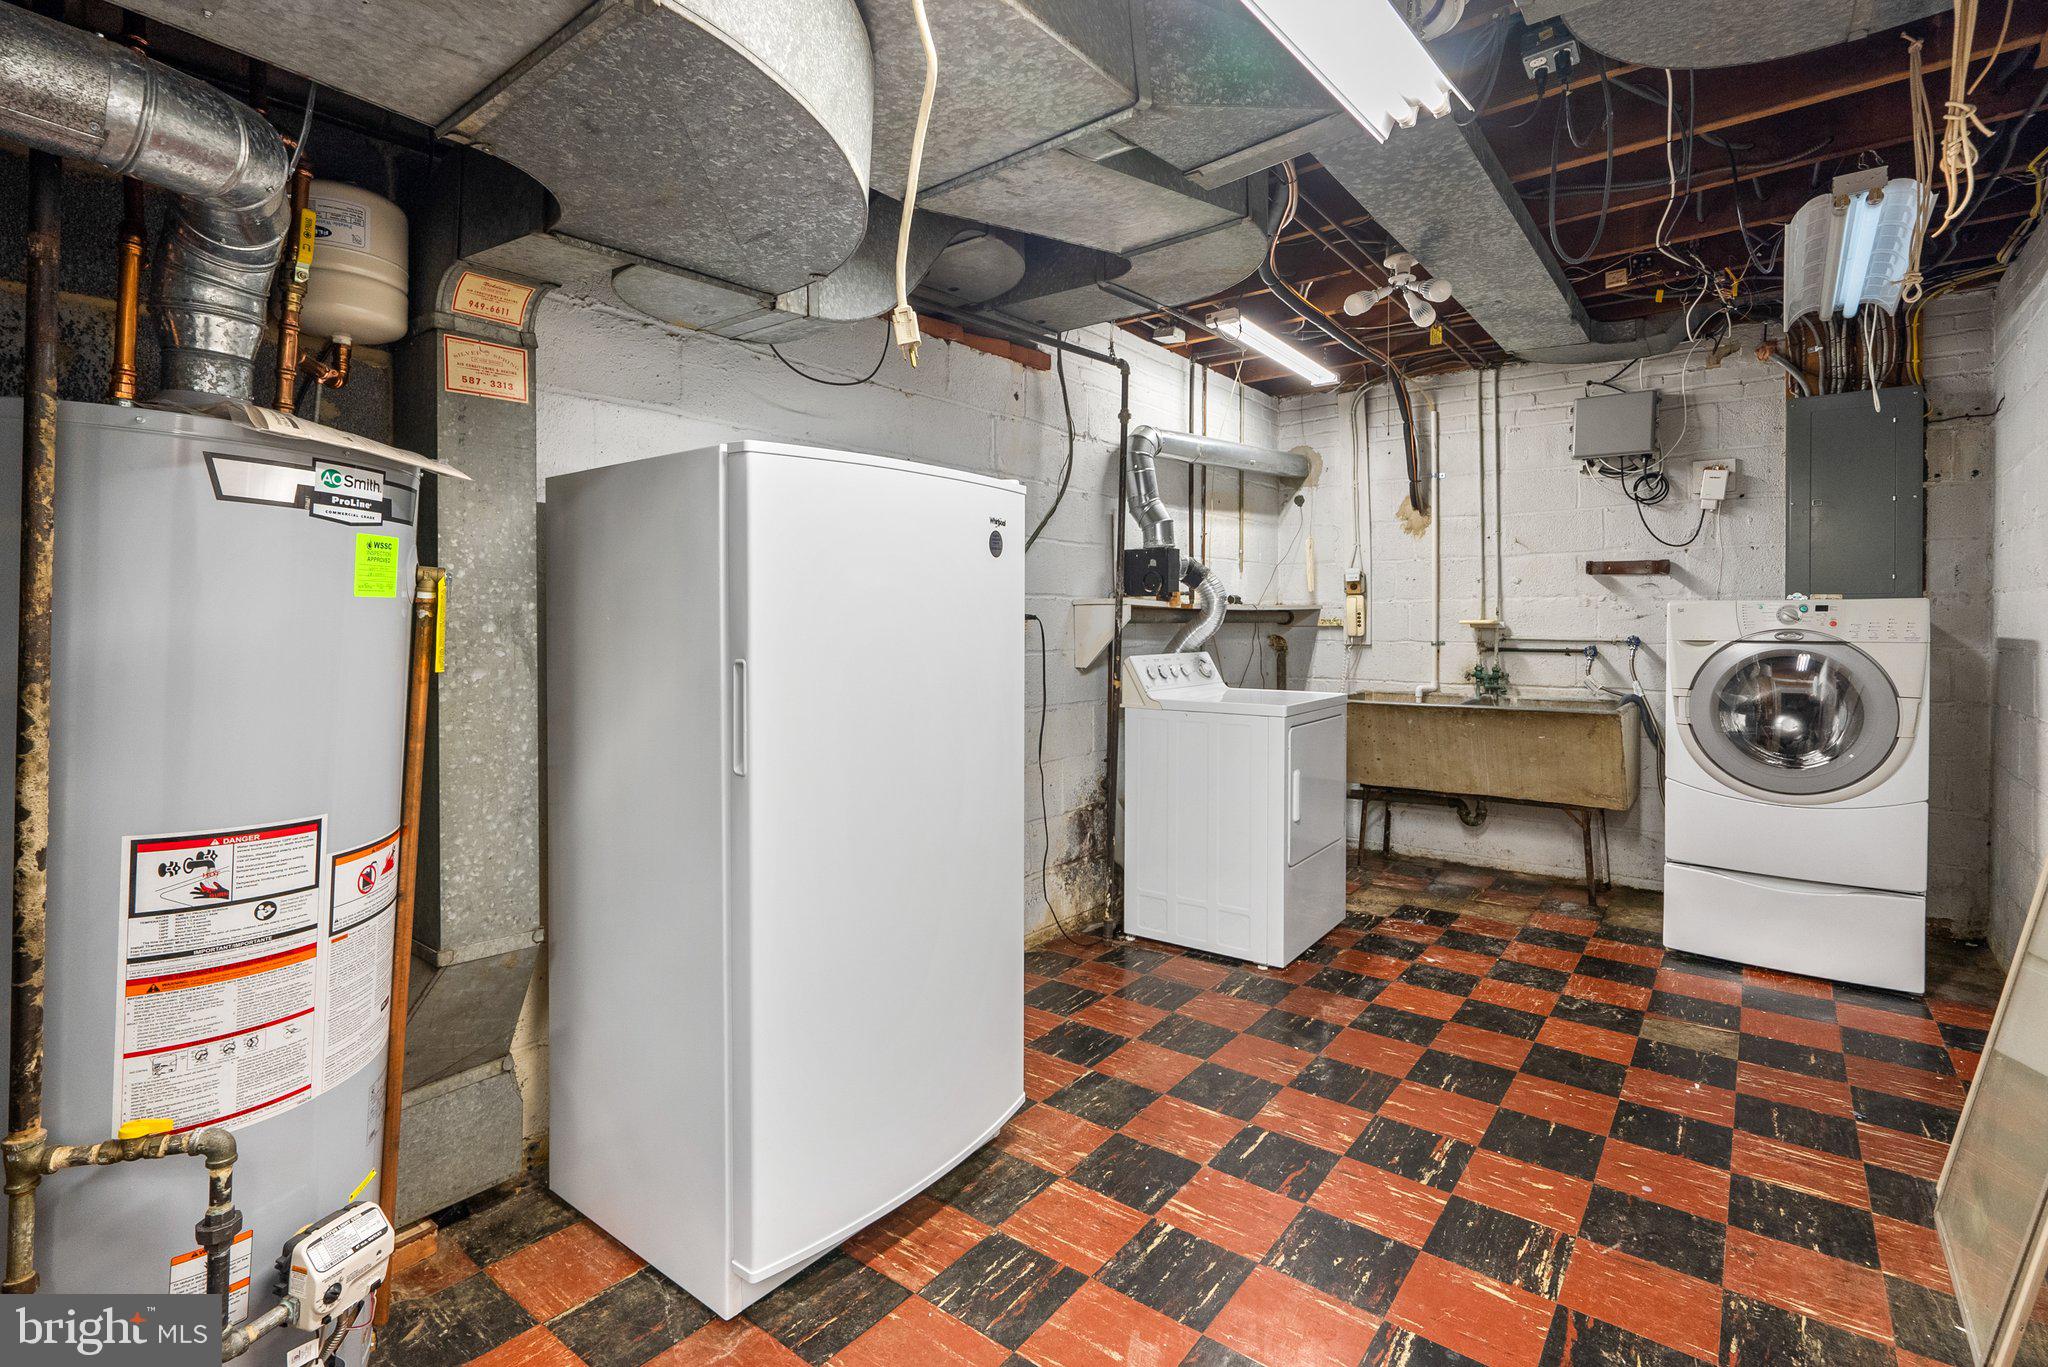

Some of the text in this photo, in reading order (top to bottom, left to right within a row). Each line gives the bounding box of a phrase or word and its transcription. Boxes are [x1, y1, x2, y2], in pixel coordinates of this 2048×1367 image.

[469, 300, 509, 316] 949-6611
[344, 475, 380, 493] Smith
[332, 496, 370, 509] ProLine
[374, 542, 392, 550] WSSC
[223, 835, 260, 844] DANGER
